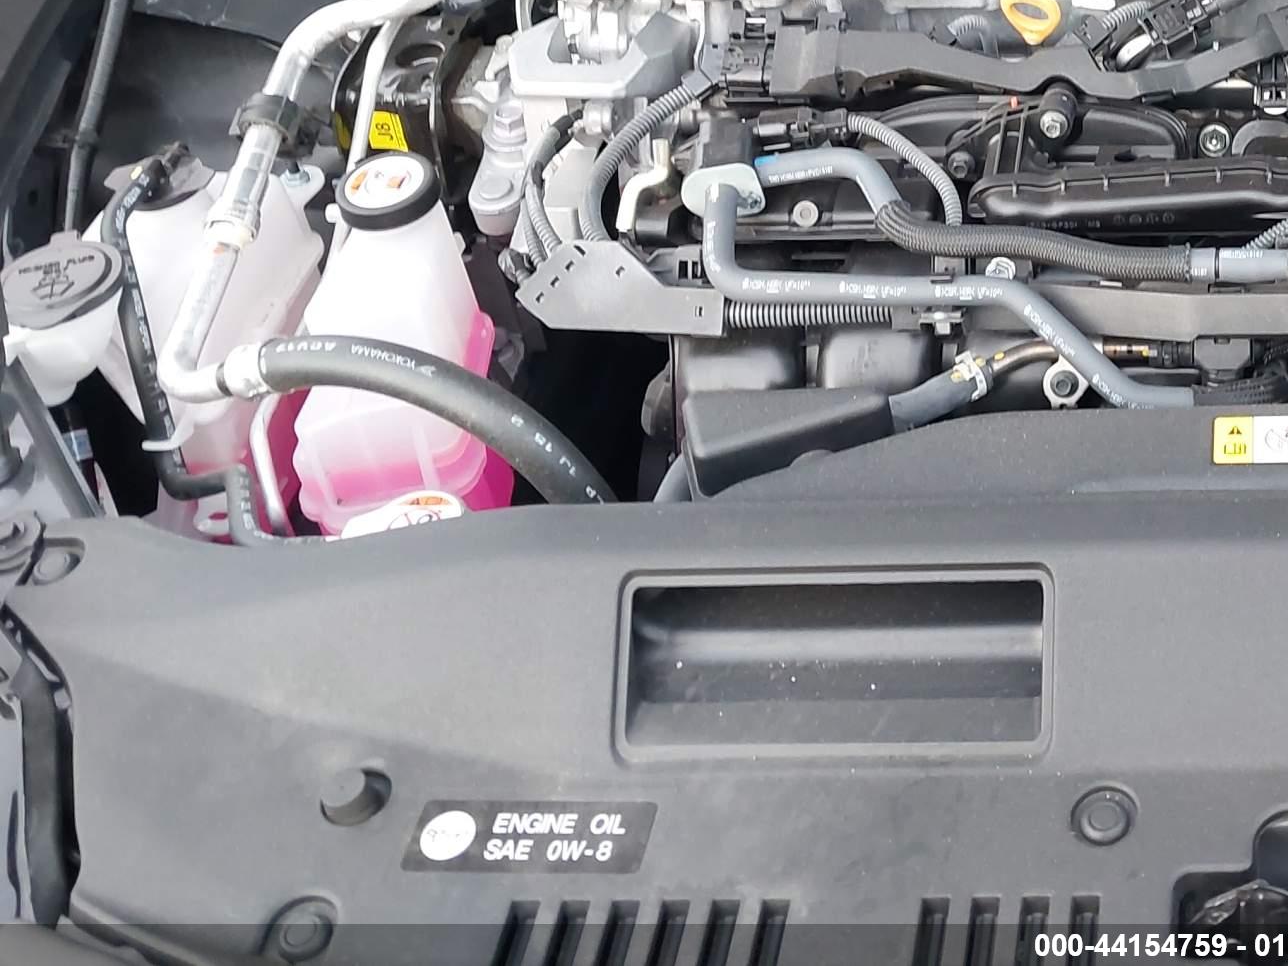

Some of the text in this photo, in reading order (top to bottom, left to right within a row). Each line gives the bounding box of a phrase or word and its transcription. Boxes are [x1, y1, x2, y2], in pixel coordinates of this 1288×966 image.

[351, 342, 416, 371] YOKOHAMA
[492, 812, 627, 835] ENGINE OIL
[483, 838, 613, 862] SAE 0W-8
